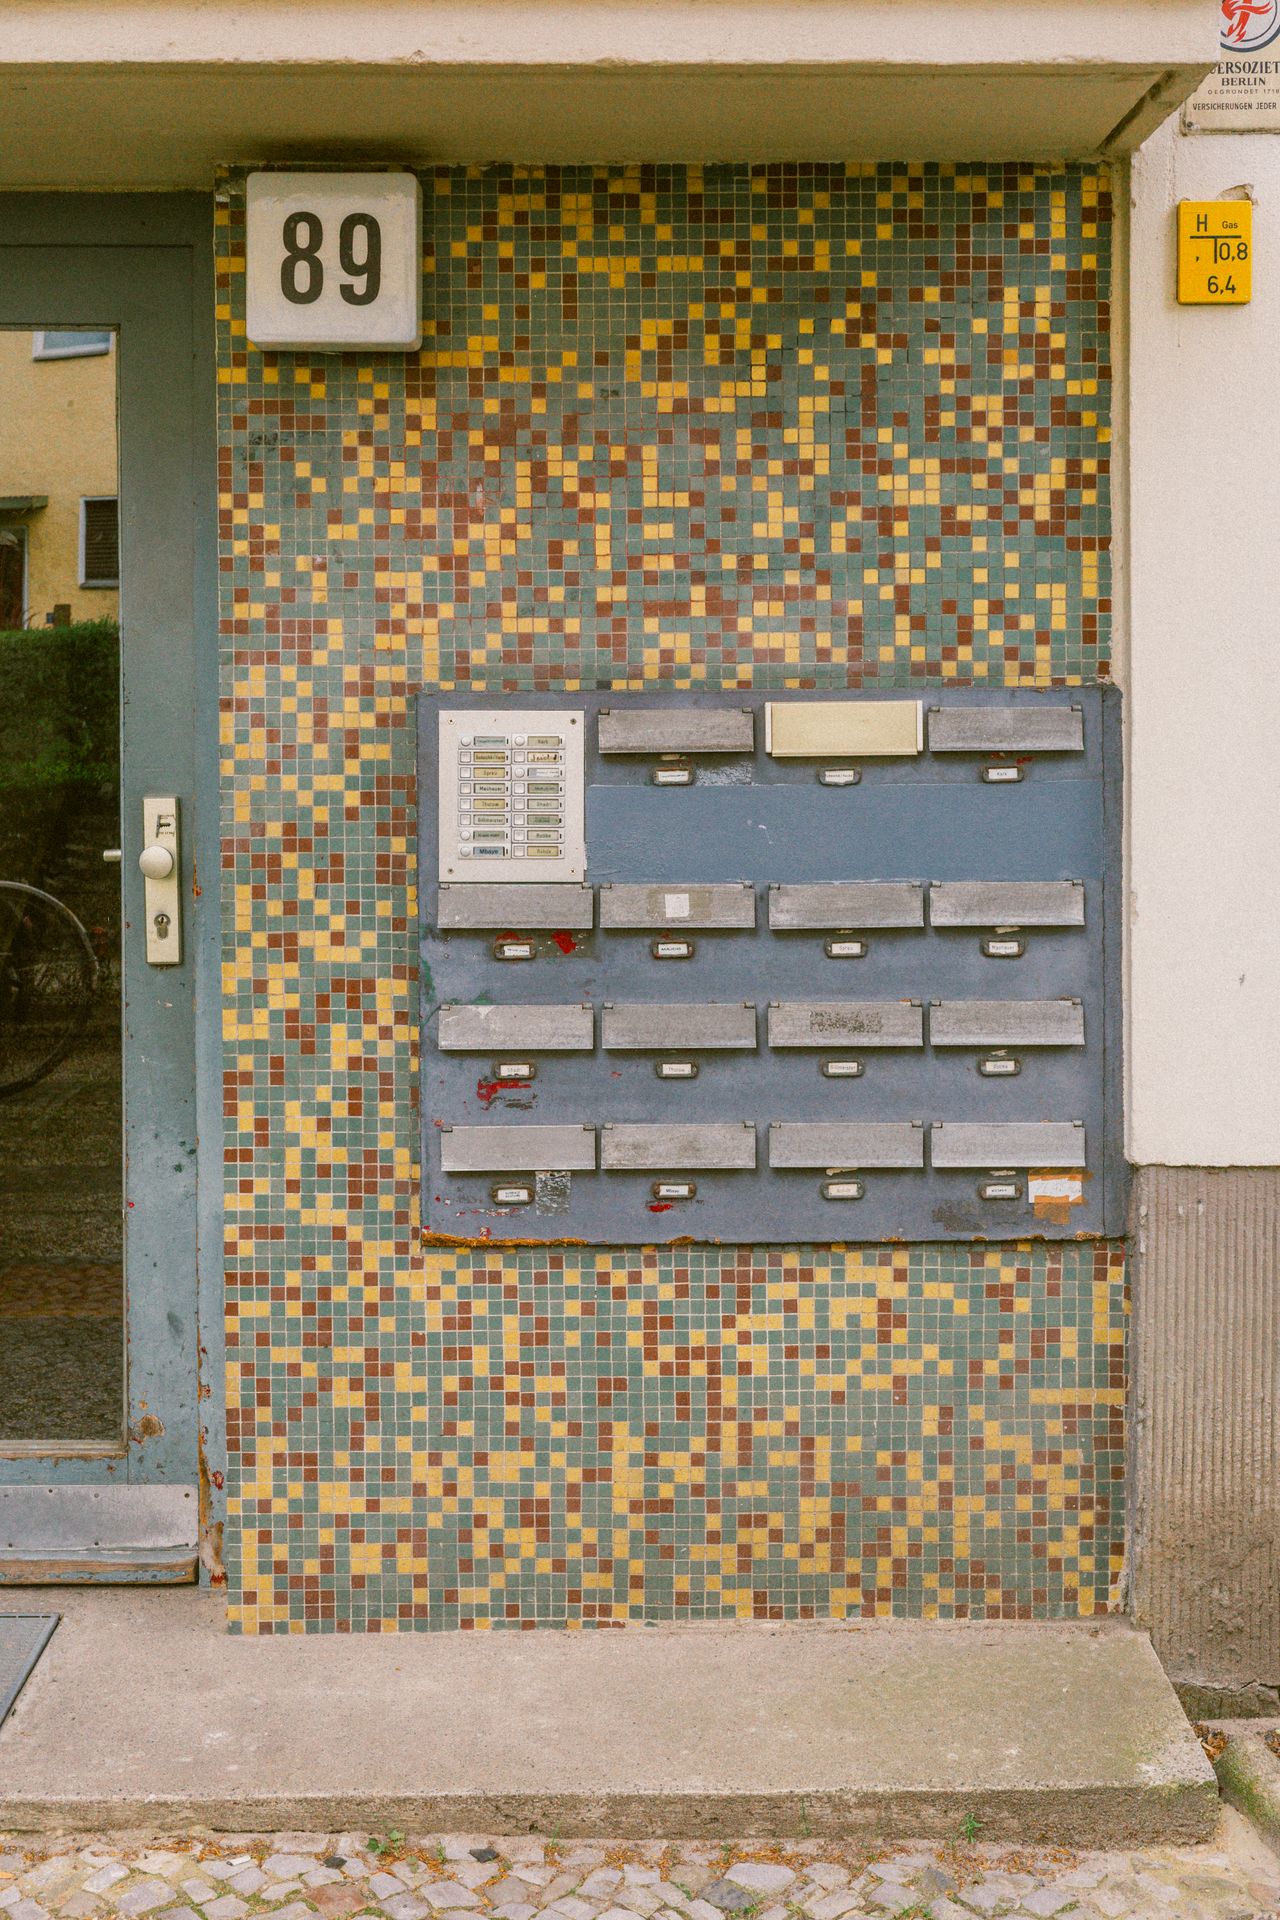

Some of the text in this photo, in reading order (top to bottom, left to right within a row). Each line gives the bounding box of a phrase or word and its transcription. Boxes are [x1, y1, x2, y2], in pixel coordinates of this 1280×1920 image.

[1221, 77, 1266, 86] BERLIN
[1192, 102, 1277, 110] VERSICHERUNGEN JEDER
[1196, 213, 1239, 233] H Gas
[280, 210, 382, 307] 89
[1218, 242, 1249, 262] 0,8
[1207, 275, 1237, 295] 6,4
